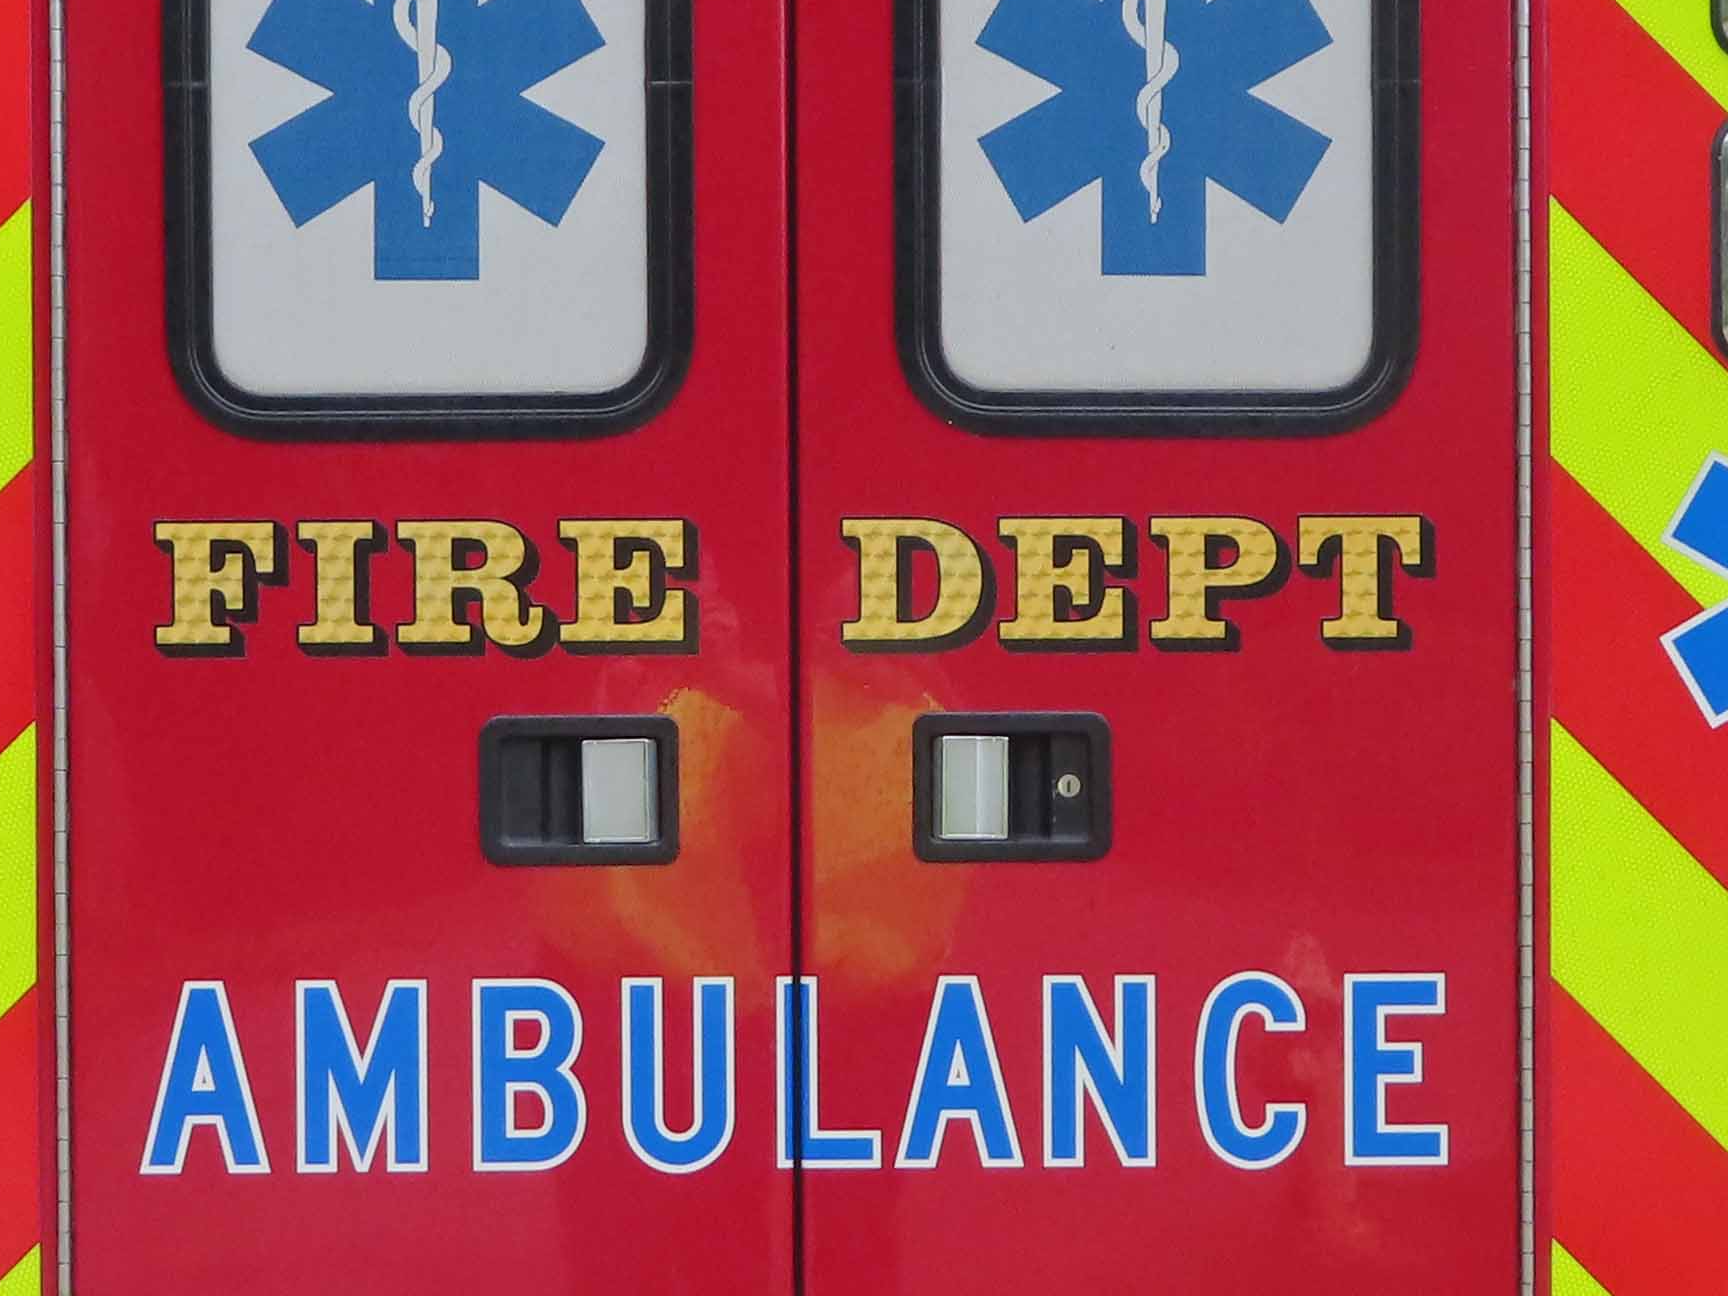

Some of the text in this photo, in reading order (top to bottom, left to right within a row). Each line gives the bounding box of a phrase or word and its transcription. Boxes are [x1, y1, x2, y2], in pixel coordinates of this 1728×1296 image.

[151, 515, 1436, 658] FIRE DEPT
[139, 971, 1450, 1176] AMBULANCE
